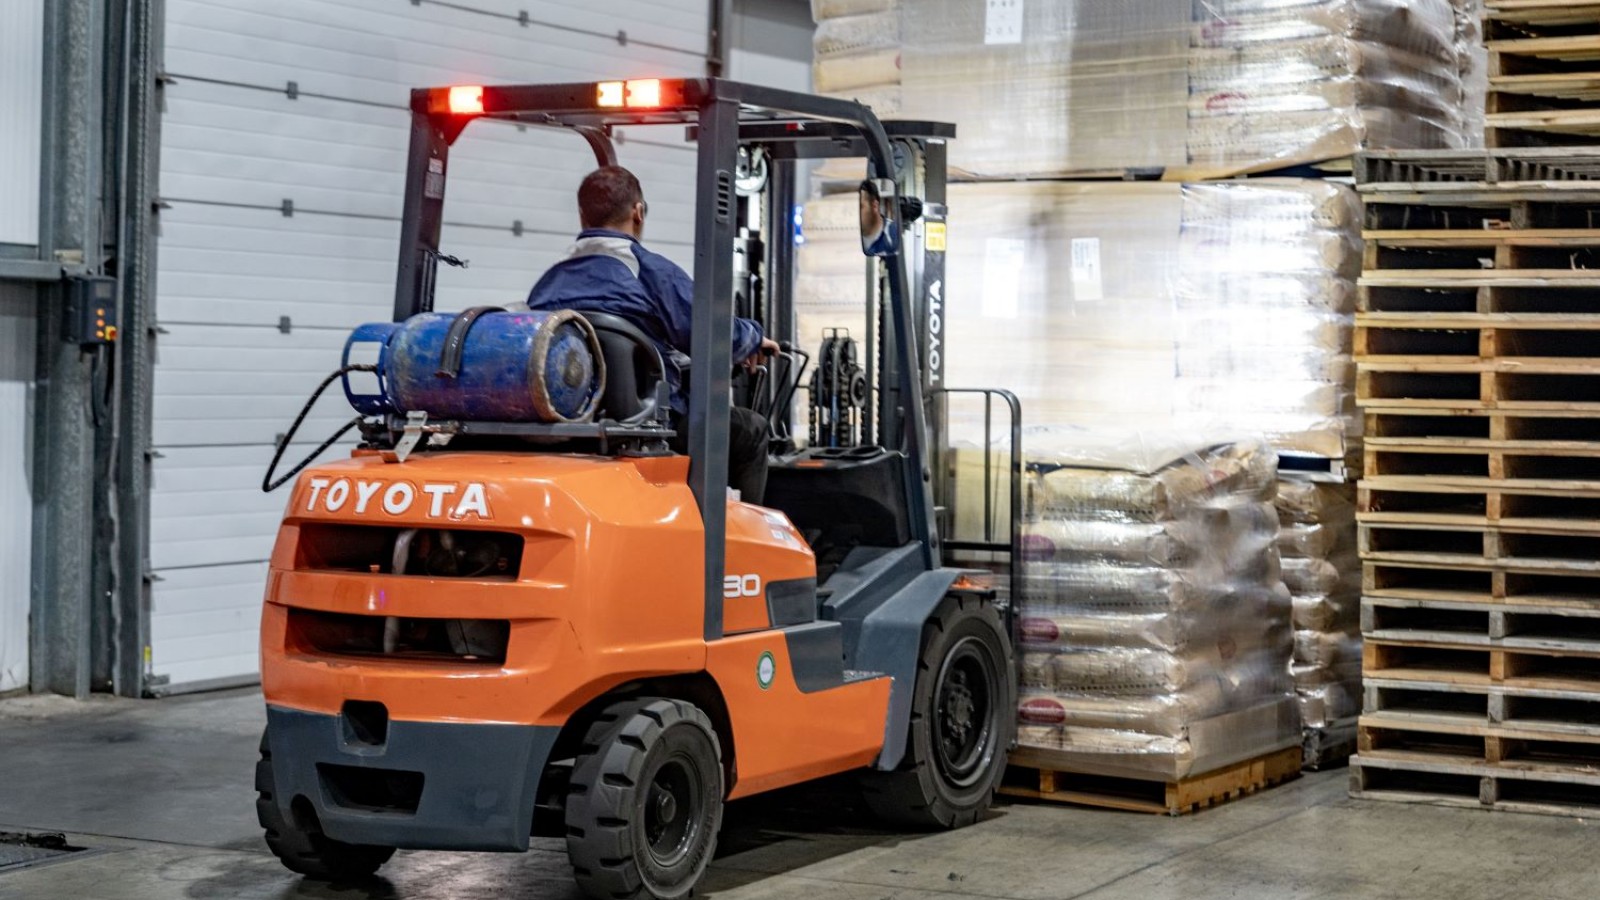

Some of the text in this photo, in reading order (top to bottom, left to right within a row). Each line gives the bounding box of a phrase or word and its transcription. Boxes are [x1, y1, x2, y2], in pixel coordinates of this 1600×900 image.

[929, 279, 942, 387] TOYOTA
[307, 477, 489, 517] TOYOTA
[723, 573, 761, 598] 30
